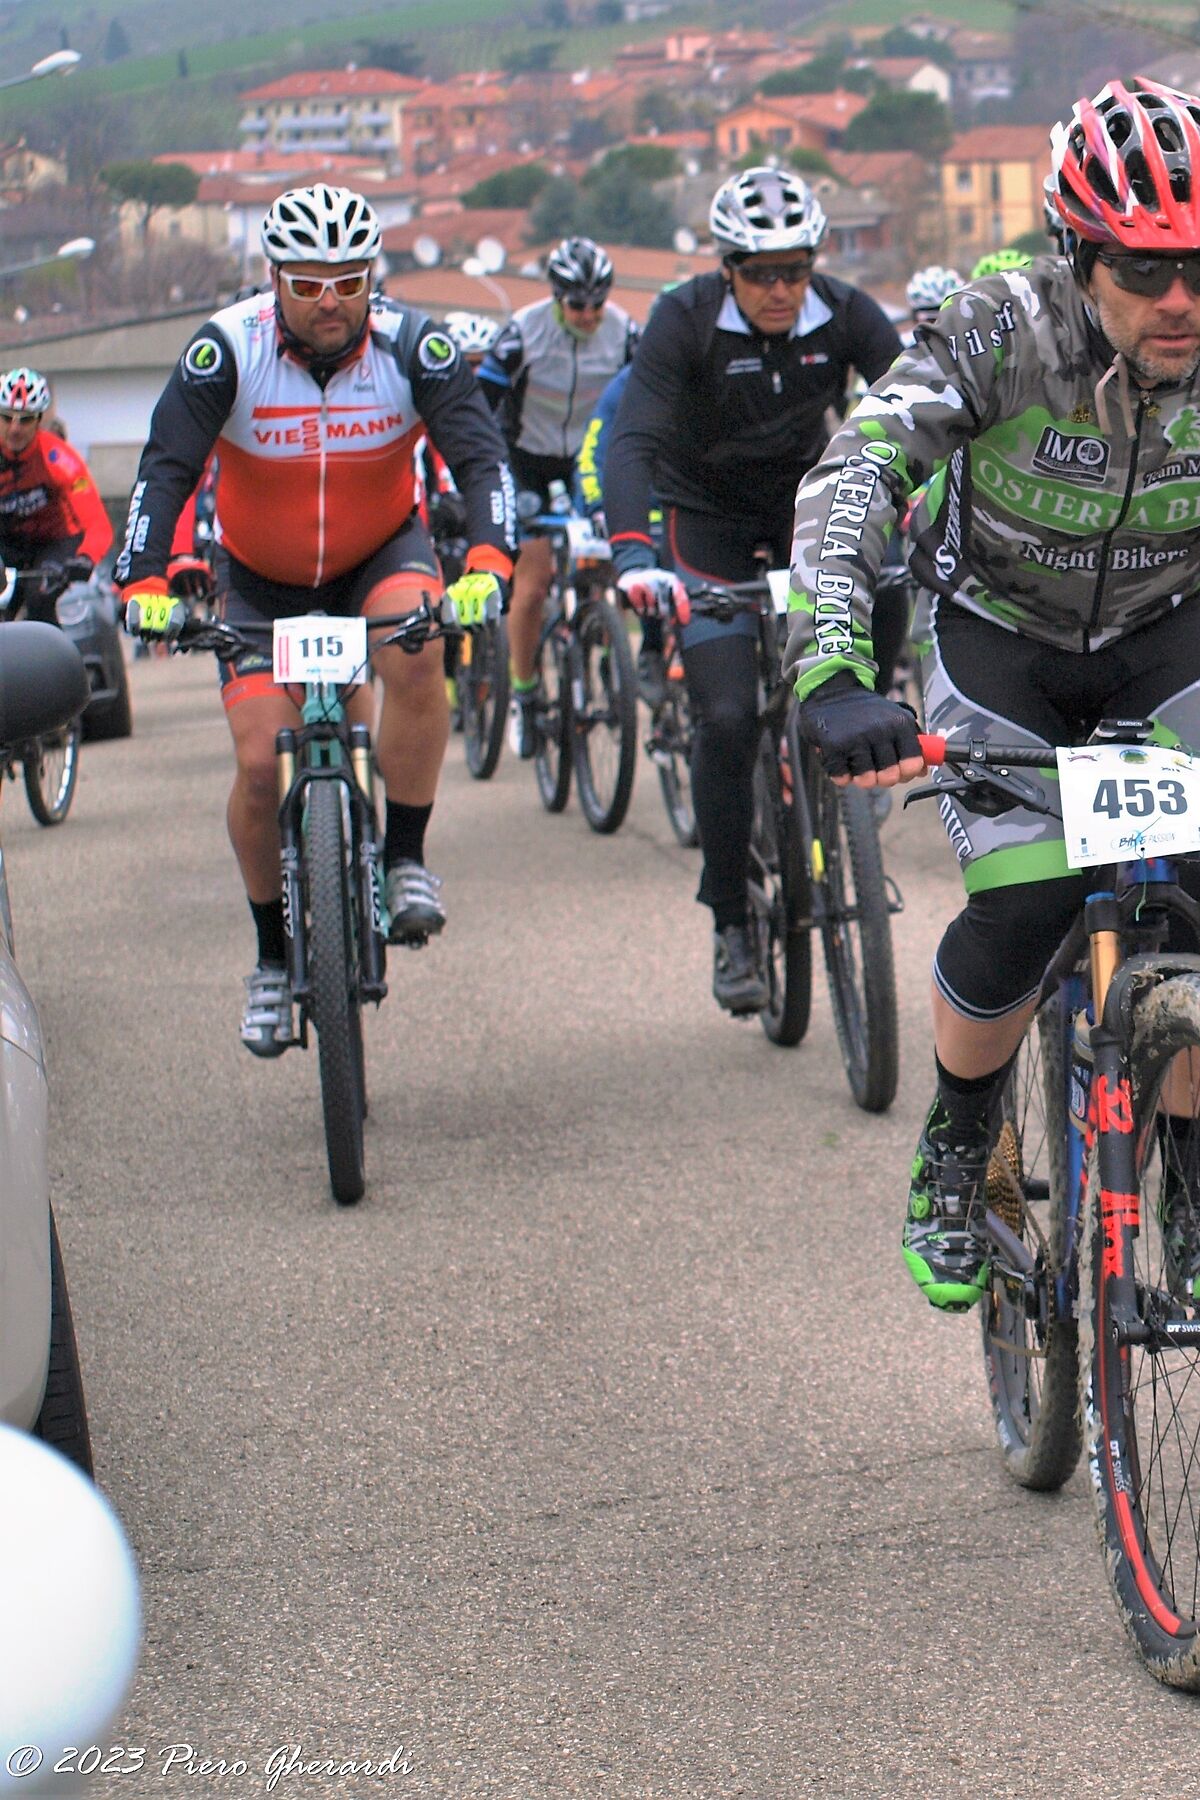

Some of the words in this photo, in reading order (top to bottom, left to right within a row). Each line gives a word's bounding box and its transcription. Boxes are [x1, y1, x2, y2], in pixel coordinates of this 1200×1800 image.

[253, 413, 404, 452] VIESSMANN
[819, 440, 898, 561] OSTERIA
[978, 459, 1150, 530] OSTERIA
[1023, 543, 1096, 571] Night
[814, 569, 854, 658] BIKE
[299, 635, 344, 658] 115
[1092, 779, 1188, 819] 453
[1166, 1324, 1181, 1333] DT
